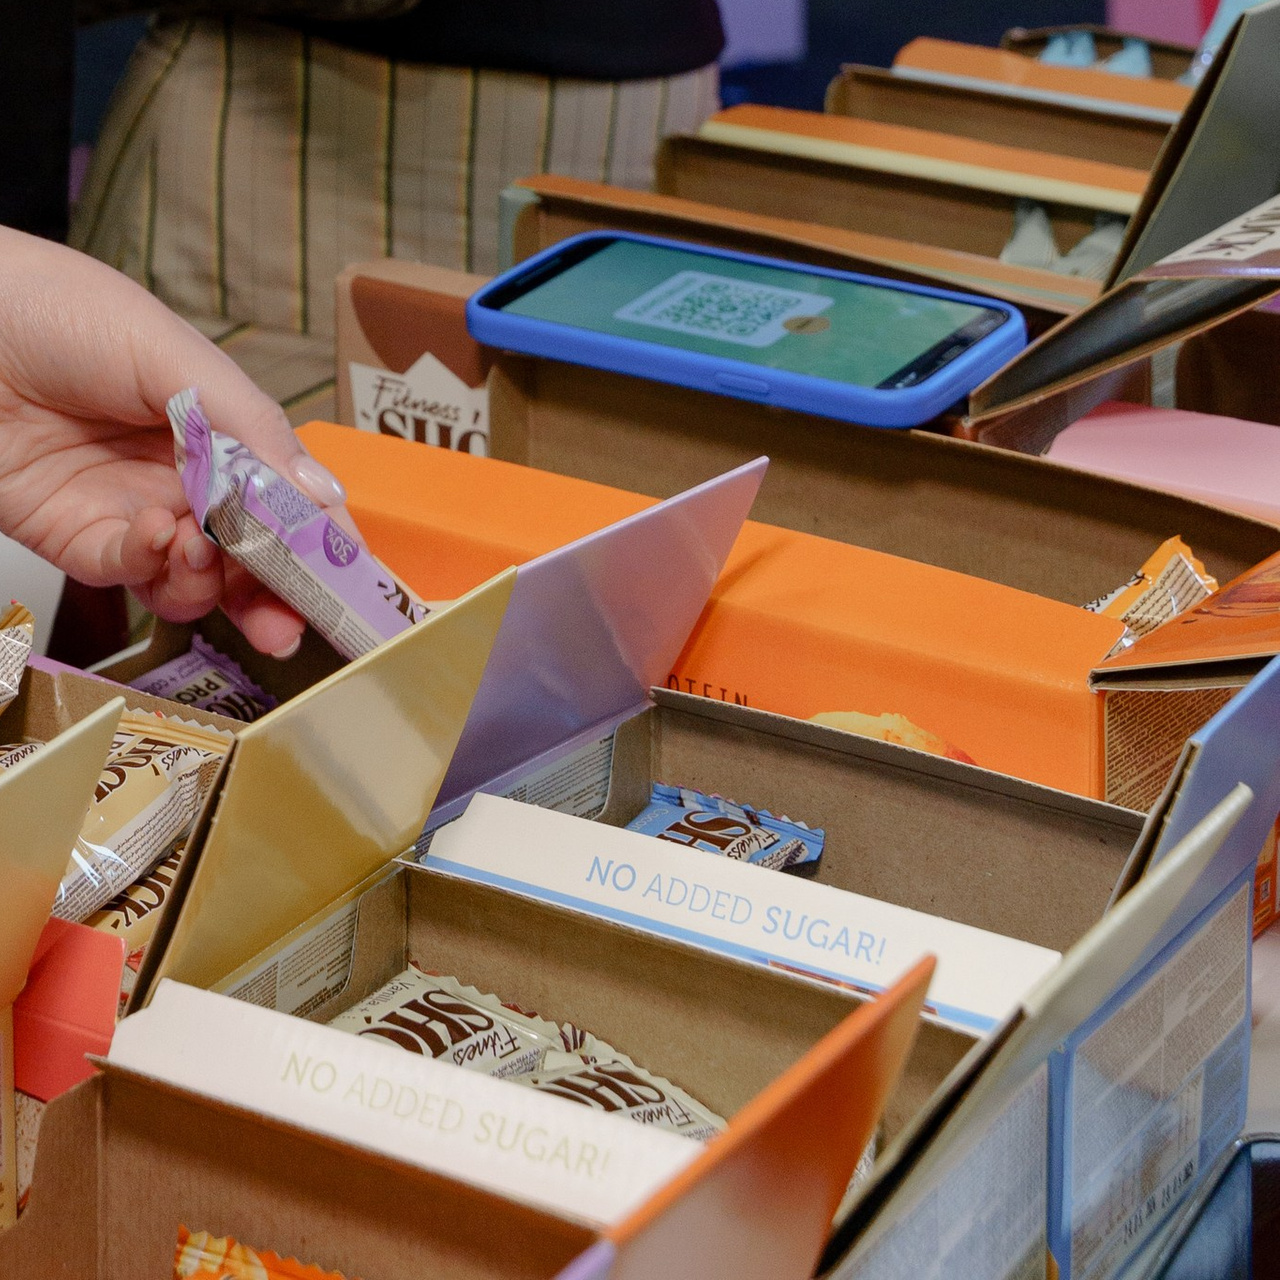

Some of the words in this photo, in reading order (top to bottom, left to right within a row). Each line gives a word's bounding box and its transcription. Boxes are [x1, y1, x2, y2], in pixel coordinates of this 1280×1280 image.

[585, 856, 637, 892] NO
[642, 873, 753, 925] ADDED
[761, 904, 887, 966] SUGAR!
[281, 1050, 337, 1096] NO
[342, 1071, 465, 1134] ADDED
[473, 1110, 612, 1180] SUGAR!
